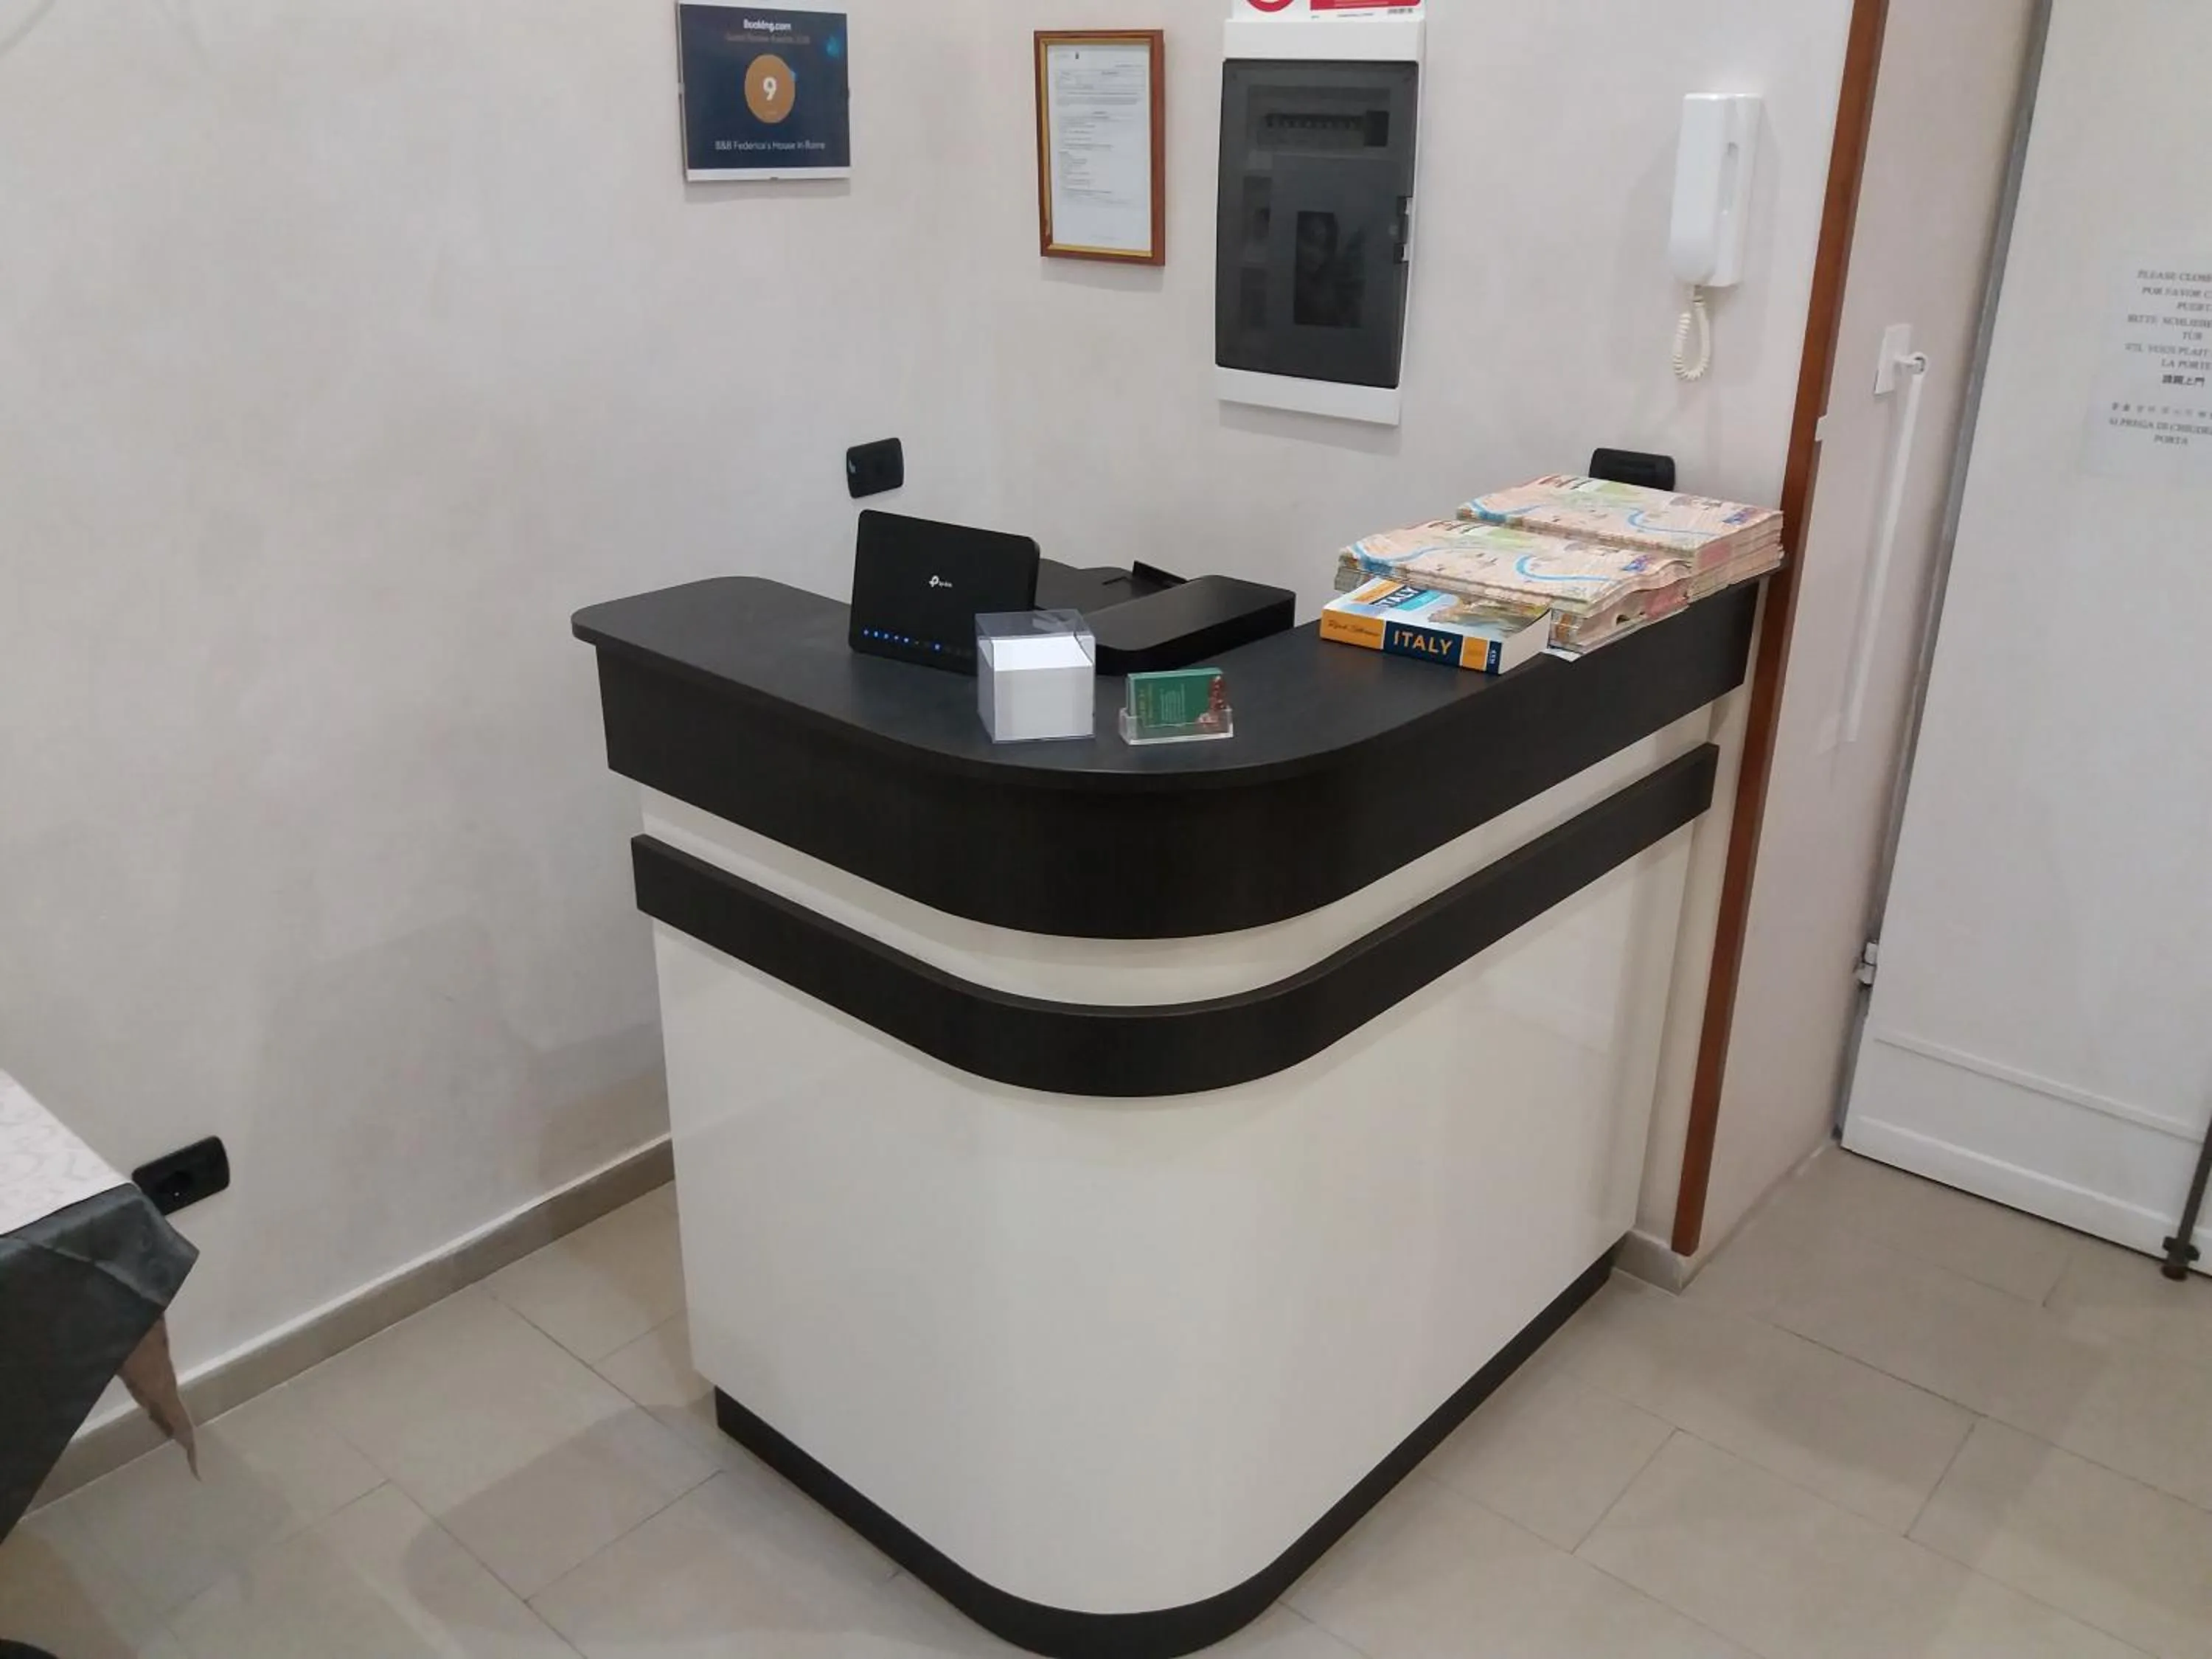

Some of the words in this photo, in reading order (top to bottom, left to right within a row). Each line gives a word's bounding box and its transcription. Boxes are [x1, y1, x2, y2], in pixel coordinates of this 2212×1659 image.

[743, 18, 792, 32] Booking.com
[762, 76, 777, 101] 9
[772, 141, 796, 150] House
[2137, 269, 2177, 280] PLEASE
[2141, 286, 2163, 296] POR
[1393, 630, 1453, 655] ITALY
